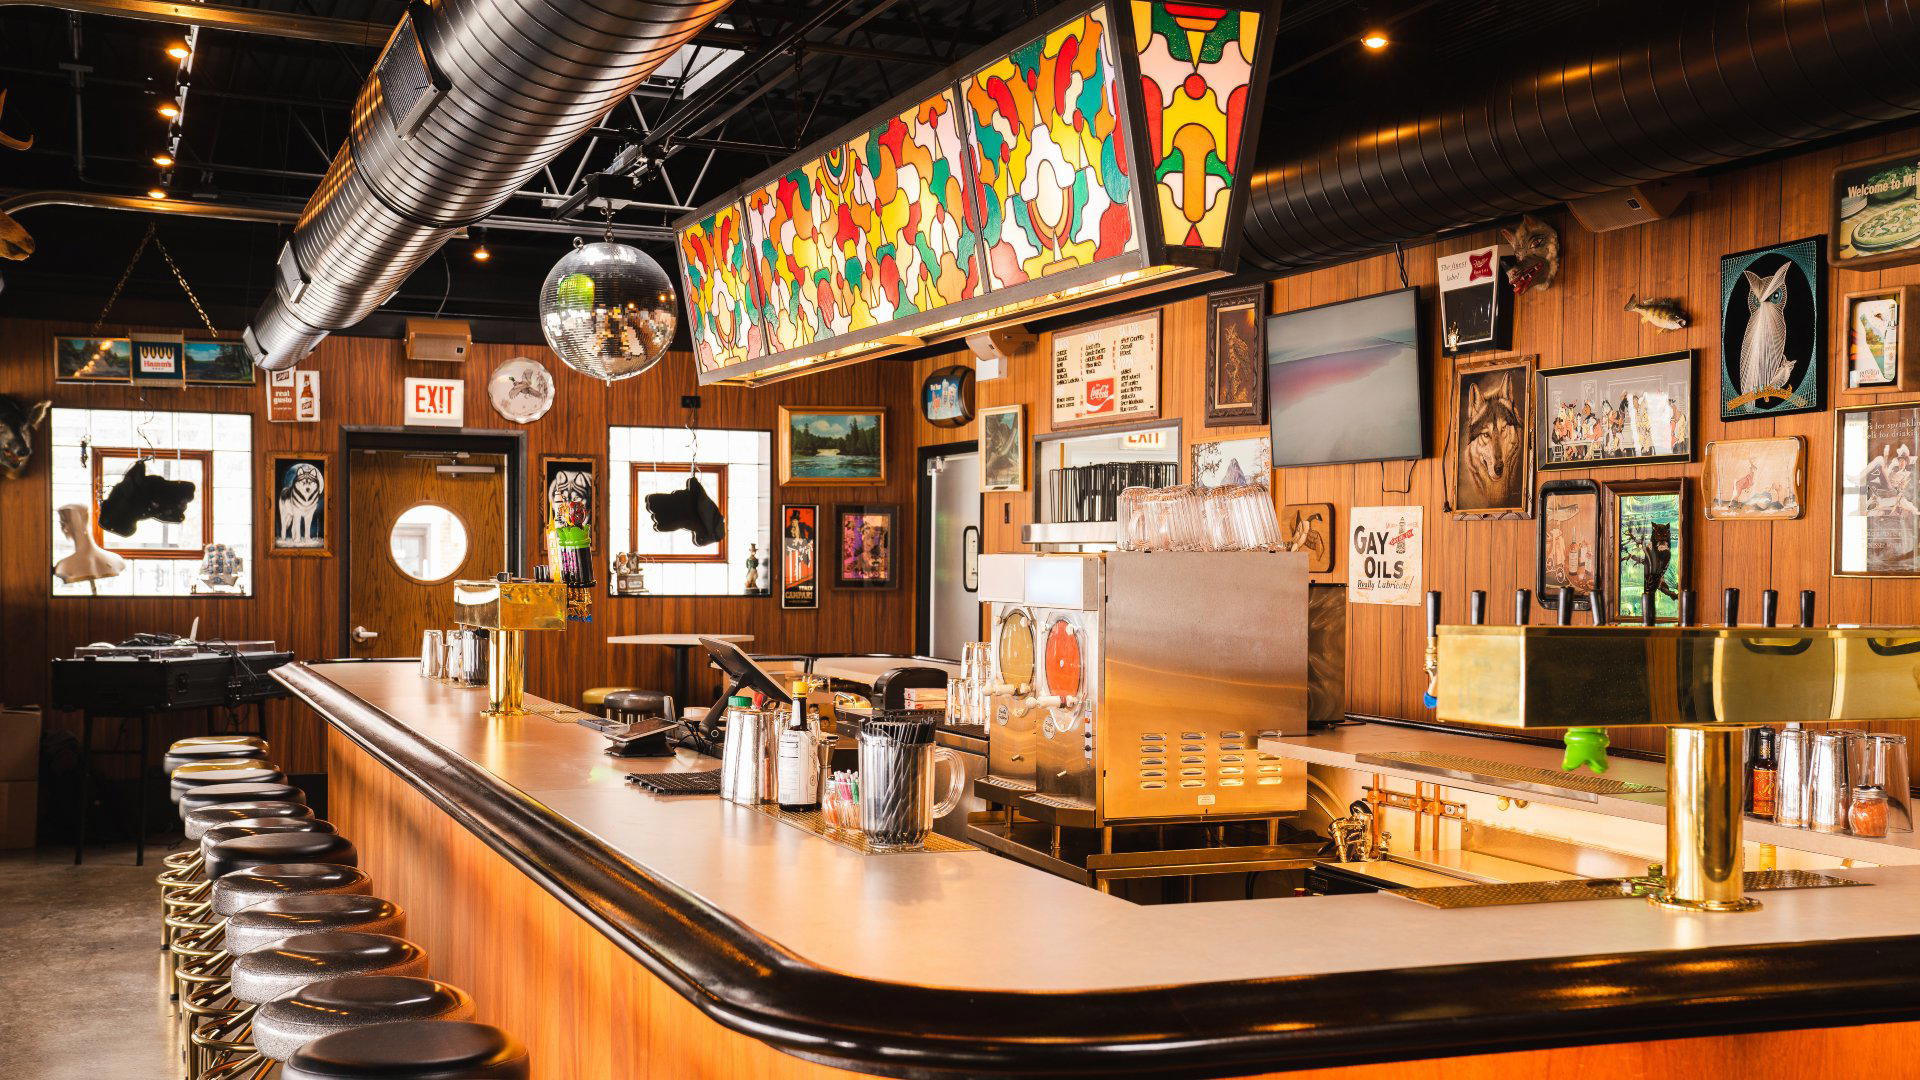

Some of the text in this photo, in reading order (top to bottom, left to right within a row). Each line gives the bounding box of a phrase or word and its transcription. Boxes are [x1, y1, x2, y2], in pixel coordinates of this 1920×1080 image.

[1848, 183, 1889, 198] Welcome
[1891, 178, 1901, 190] to
[143, 360, 172, 368] Hamm's
[275, 389, 290, 397] real
[273, 397, 293, 405] gusto
[415, 384, 455, 415] EXIT
[1354, 525, 1389, 555] GAY
[1364, 556, 1405, 579] OILS
[1357, 580, 1375, 591] Really
[784, 591, 813, 600] CAMPARI
